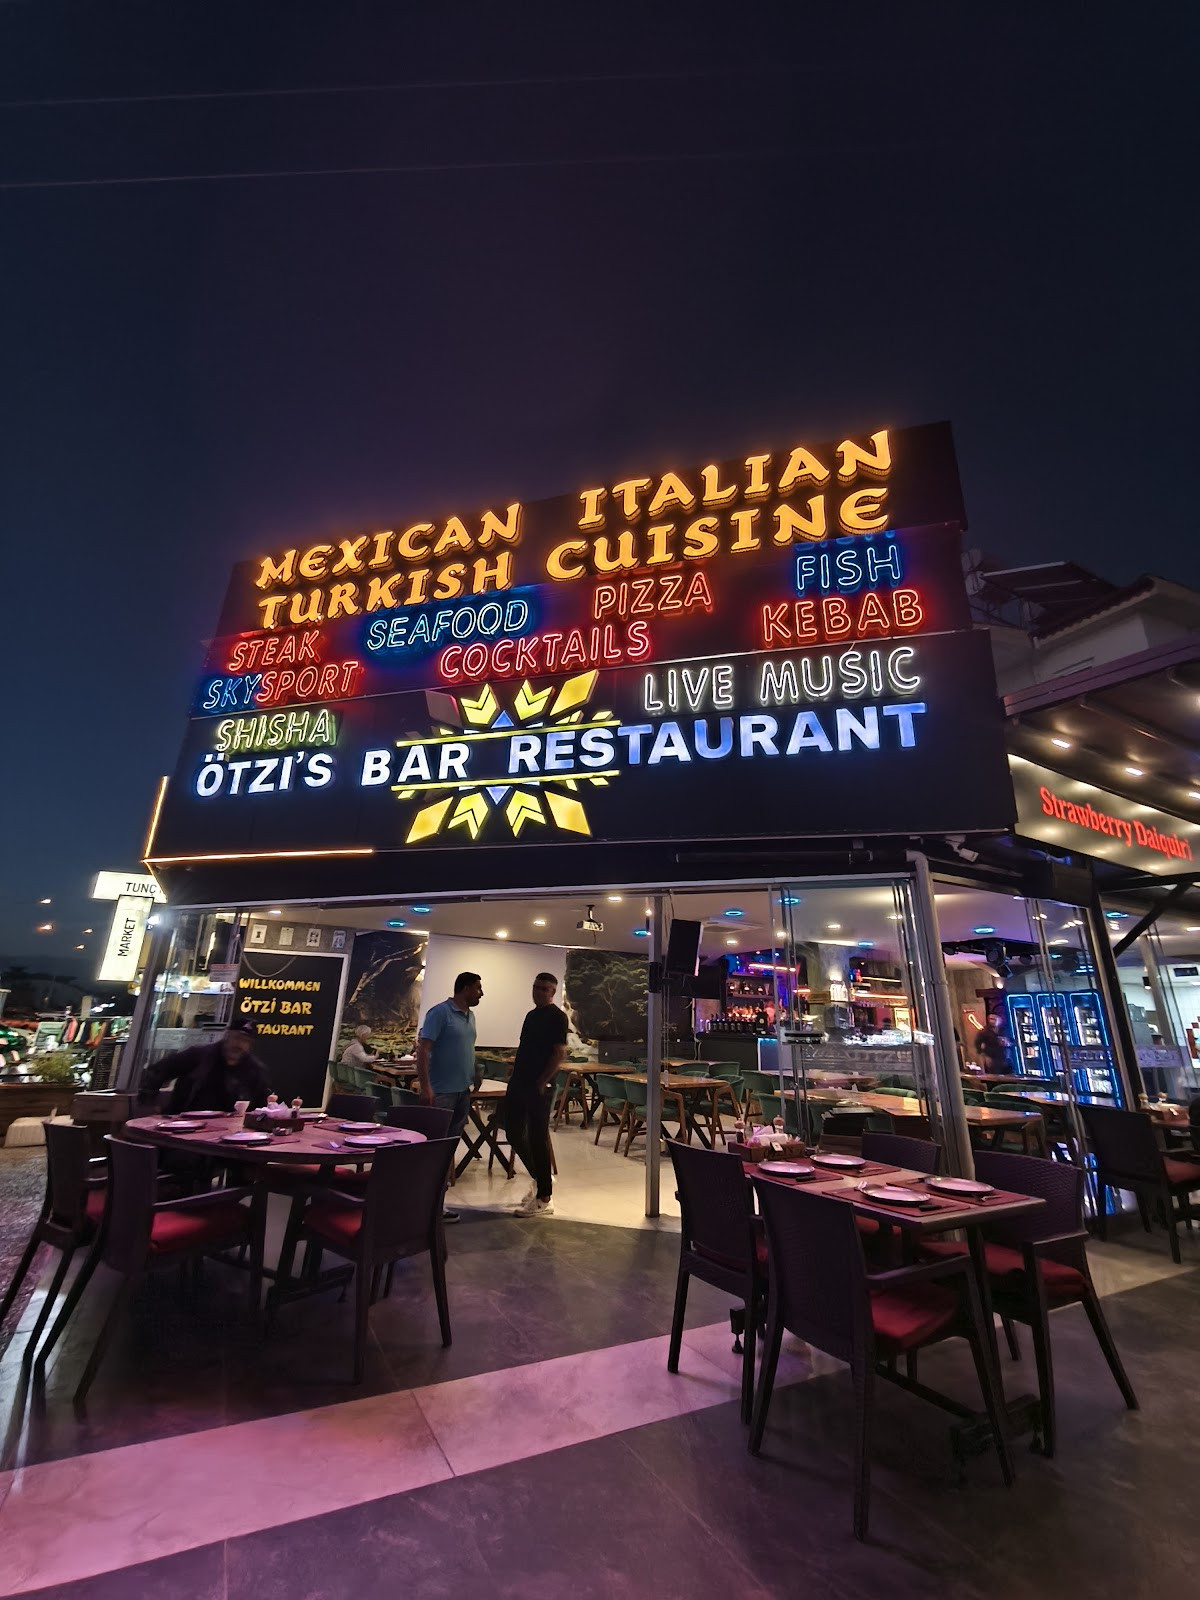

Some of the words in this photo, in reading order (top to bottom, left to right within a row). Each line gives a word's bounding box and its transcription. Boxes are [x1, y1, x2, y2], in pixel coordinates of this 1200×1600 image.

[256, 503, 523, 590] MEXICAN
[578, 430, 893, 529] ITALIAN
[258, 551, 514, 630] TURKISH
[546, 488, 889, 582] CUISINE
[796, 544, 901, 592] FISH
[594, 571, 713, 621] PIZZA
[762, 588, 924, 643] KEBAB
[366, 599, 529, 651] SEAFOOD
[439, 620, 651, 679] COCKTAILS
[228, 630, 320, 672] STEAK
[643, 664, 733, 712] LIVE
[759, 646, 922, 702] MUSIC
[215, 708, 332, 752] SHISHA
[360, 742, 471, 787] BAR
[507, 702, 927, 774] RESTAURANT
[1039, 785, 1134, 848] Strawberry
[1131, 818, 1195, 862] Daiquiri
[117, 917, 137, 957] MARKET
[239, 977, 321, 992] WILLKOMMEN
[279, 1001, 312, 1015] BAR
[255, 1023, 314, 1036] TAURANT
